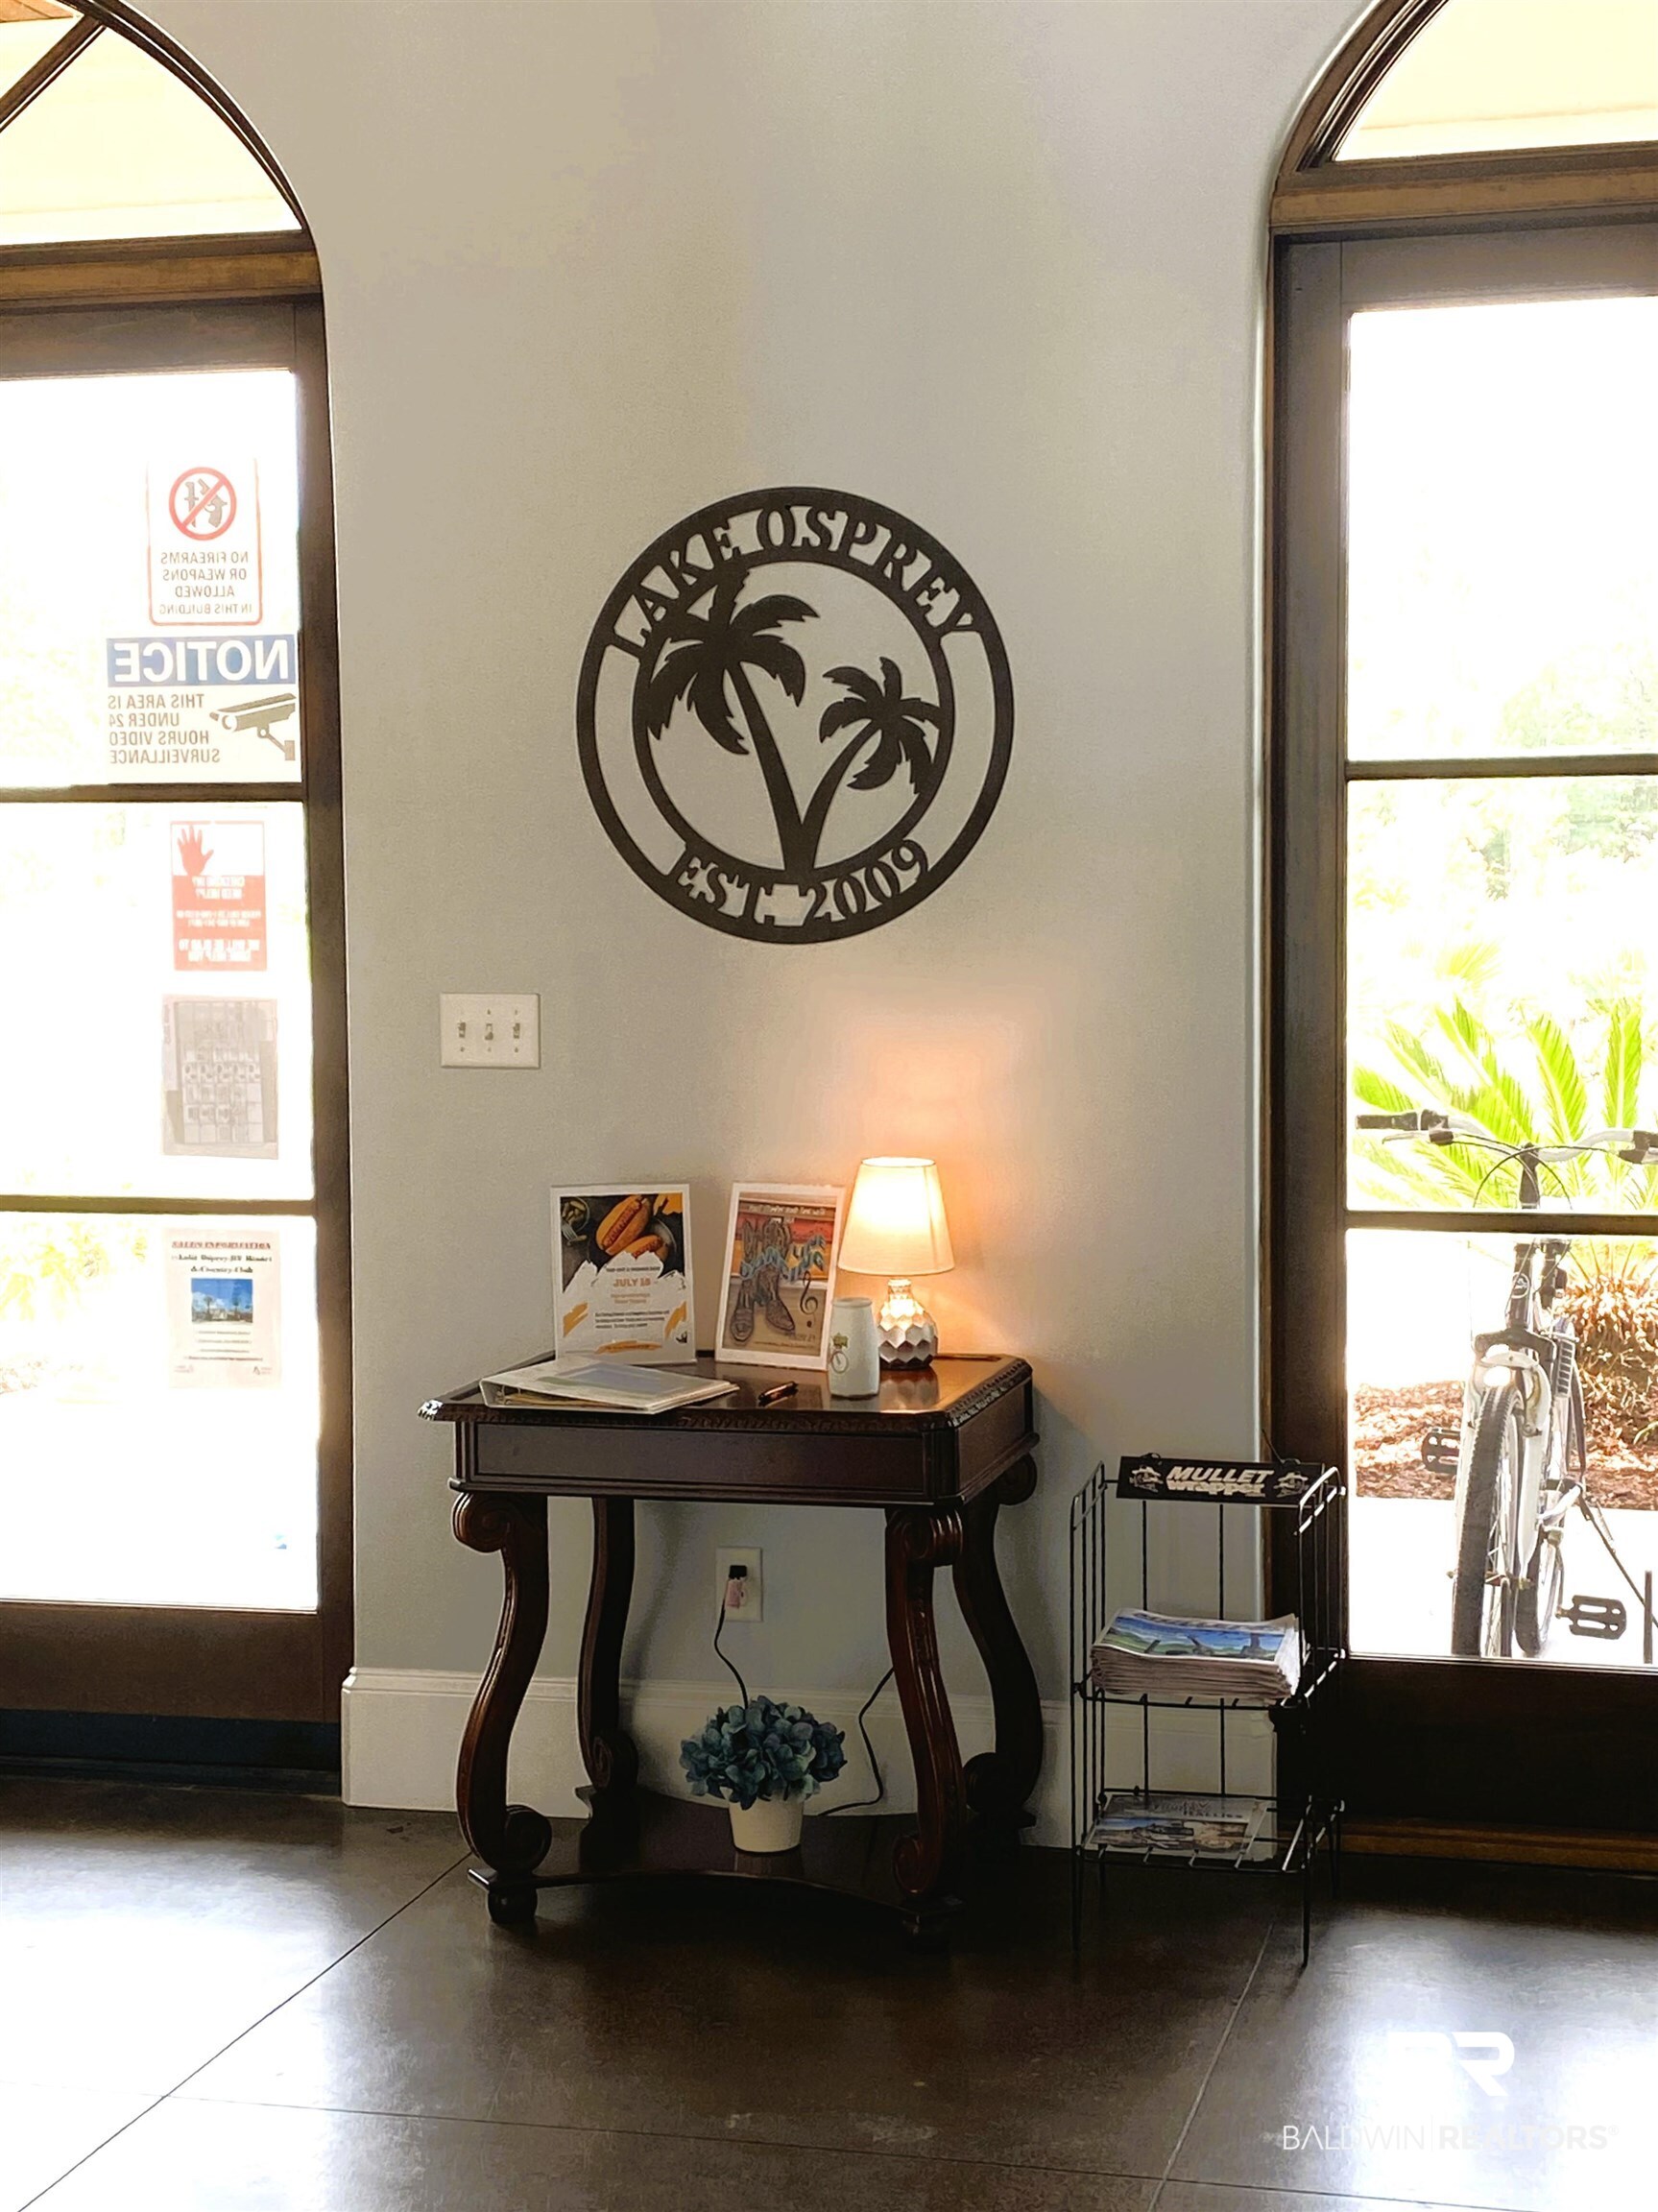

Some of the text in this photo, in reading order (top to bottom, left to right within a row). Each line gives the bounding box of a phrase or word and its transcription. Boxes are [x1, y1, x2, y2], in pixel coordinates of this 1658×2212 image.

[613, 505, 981, 660] LAKE OSPREY
[798, 838, 929, 924] 2009
[613, 1278, 639, 1287] JULY
[1165, 1465, 1275, 1484] MULLET
